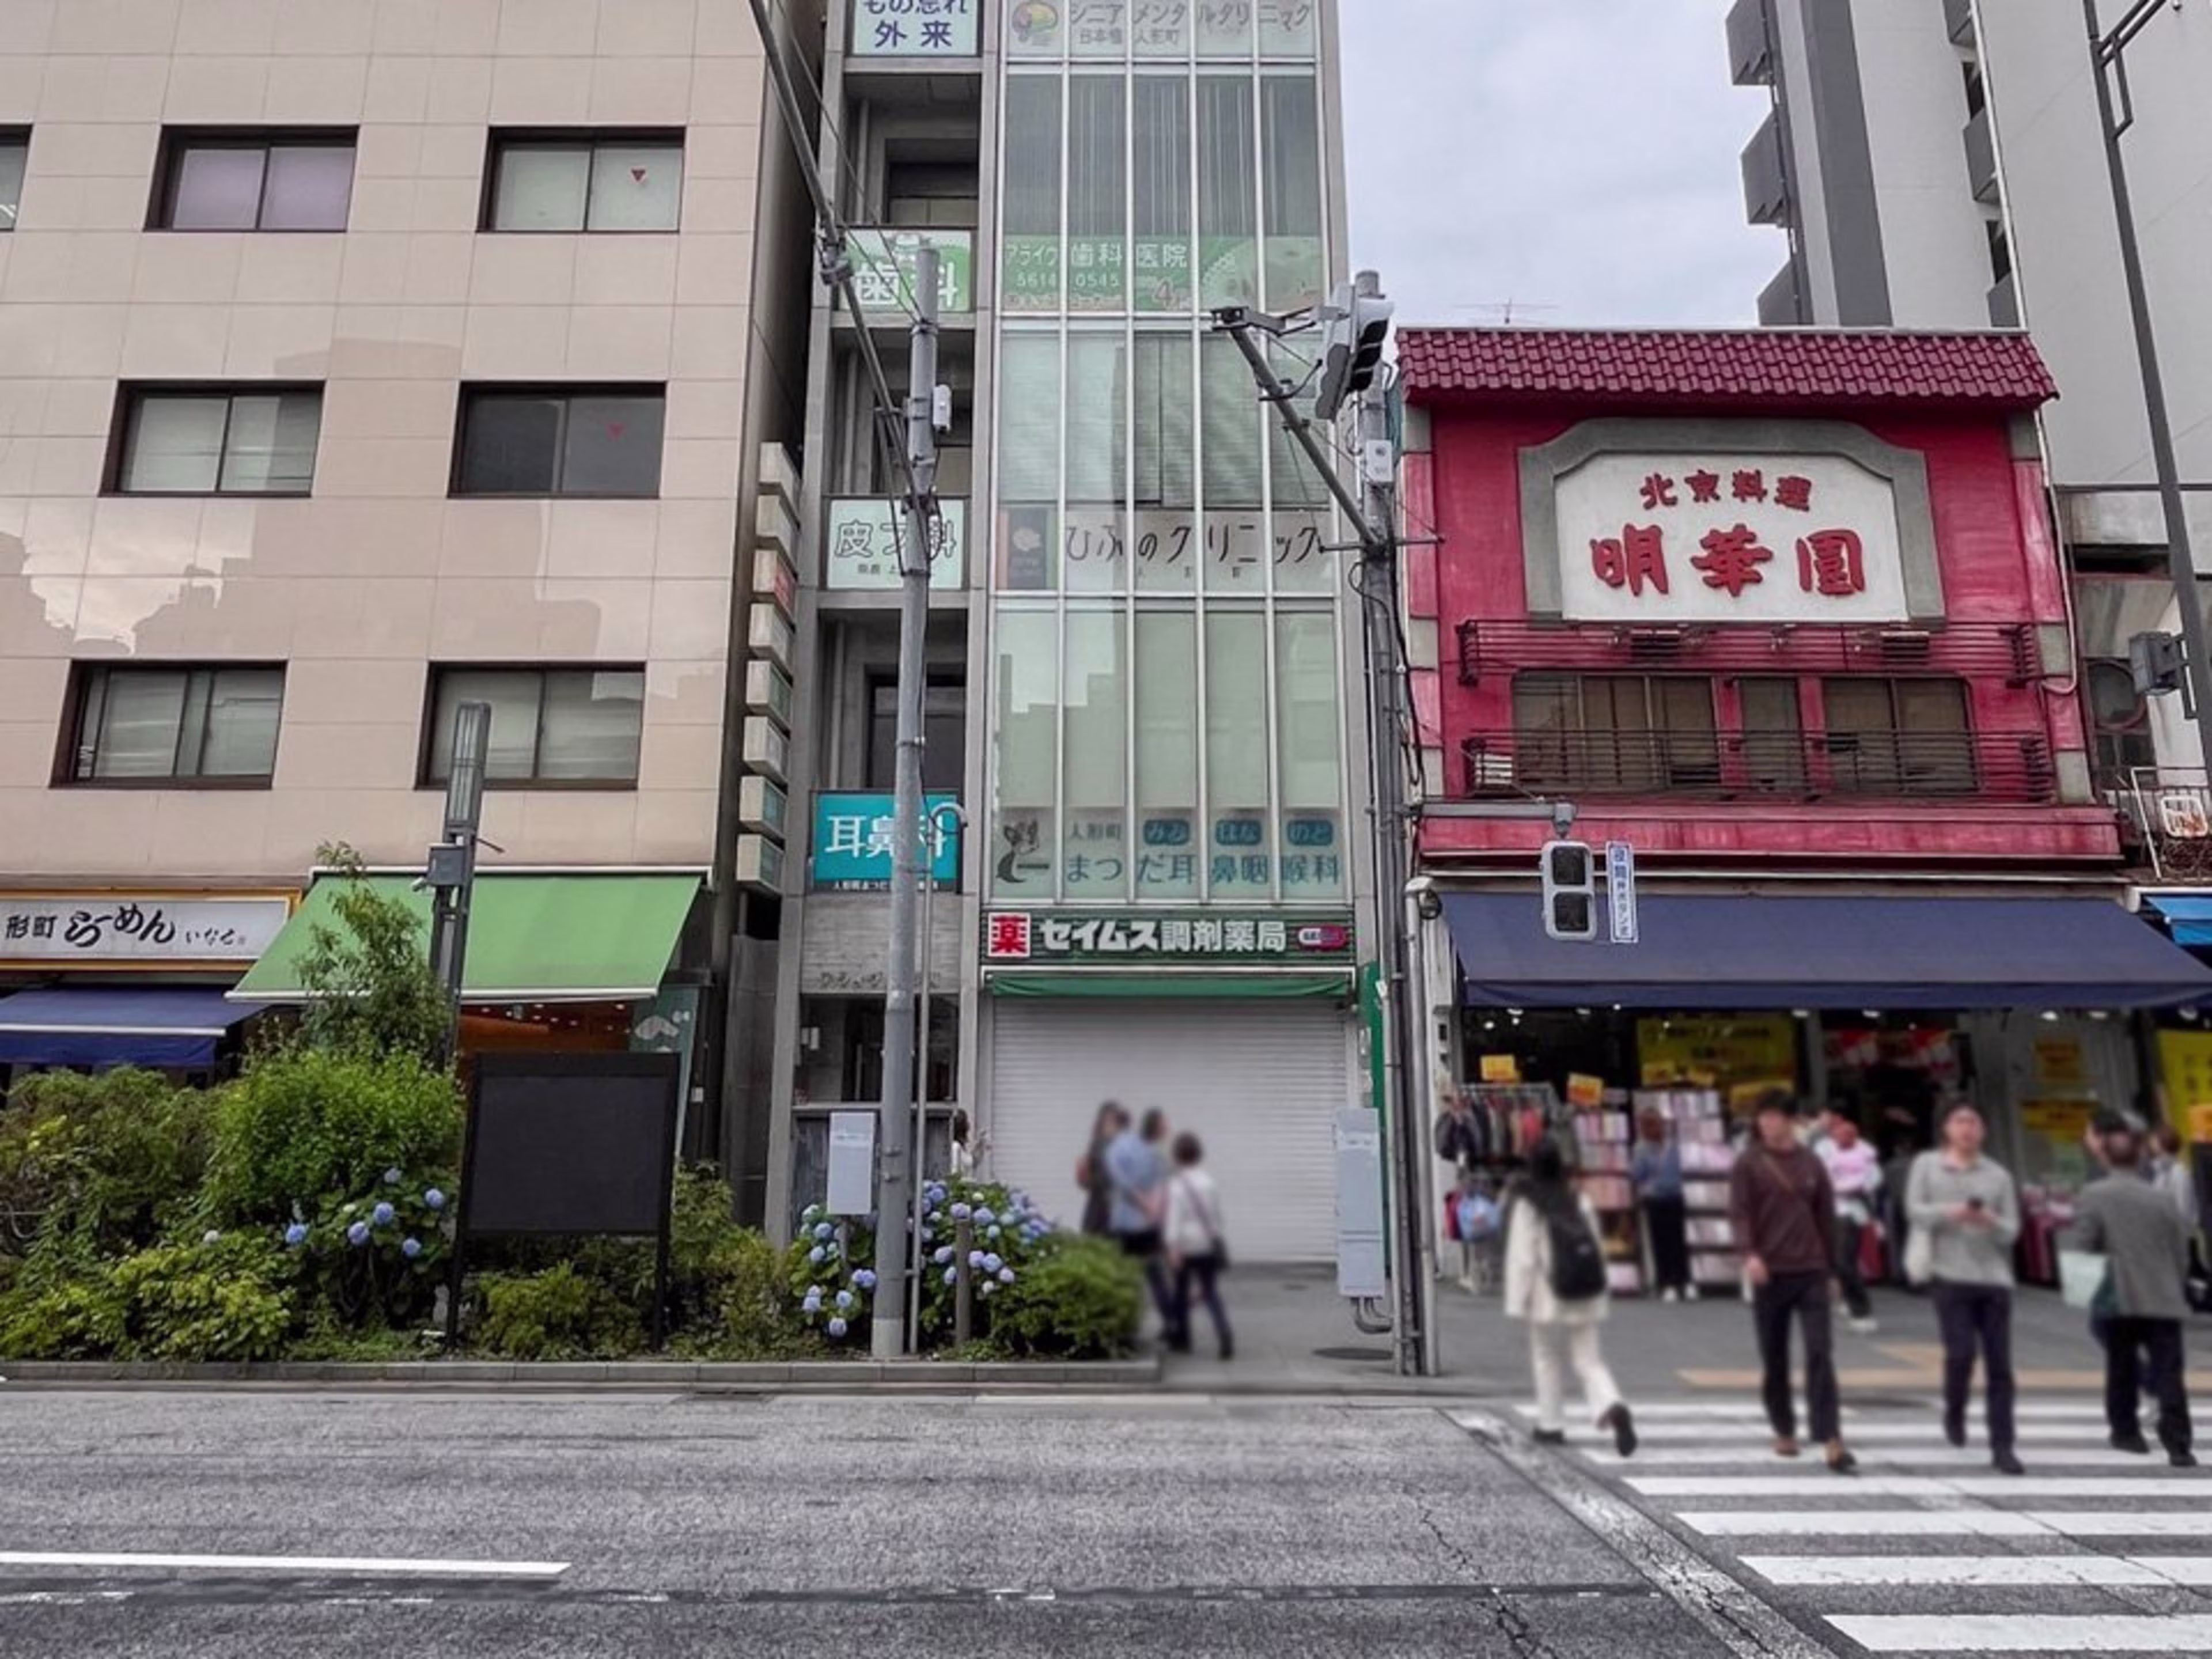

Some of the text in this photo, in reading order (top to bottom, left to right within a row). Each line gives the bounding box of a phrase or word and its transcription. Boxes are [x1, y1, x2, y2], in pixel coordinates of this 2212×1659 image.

[874, 20, 952, 48] 外来
[1639, 469, 1813, 511] 北京料理
[991, 916, 1288, 954] 薬 セイムス調剤薬局
